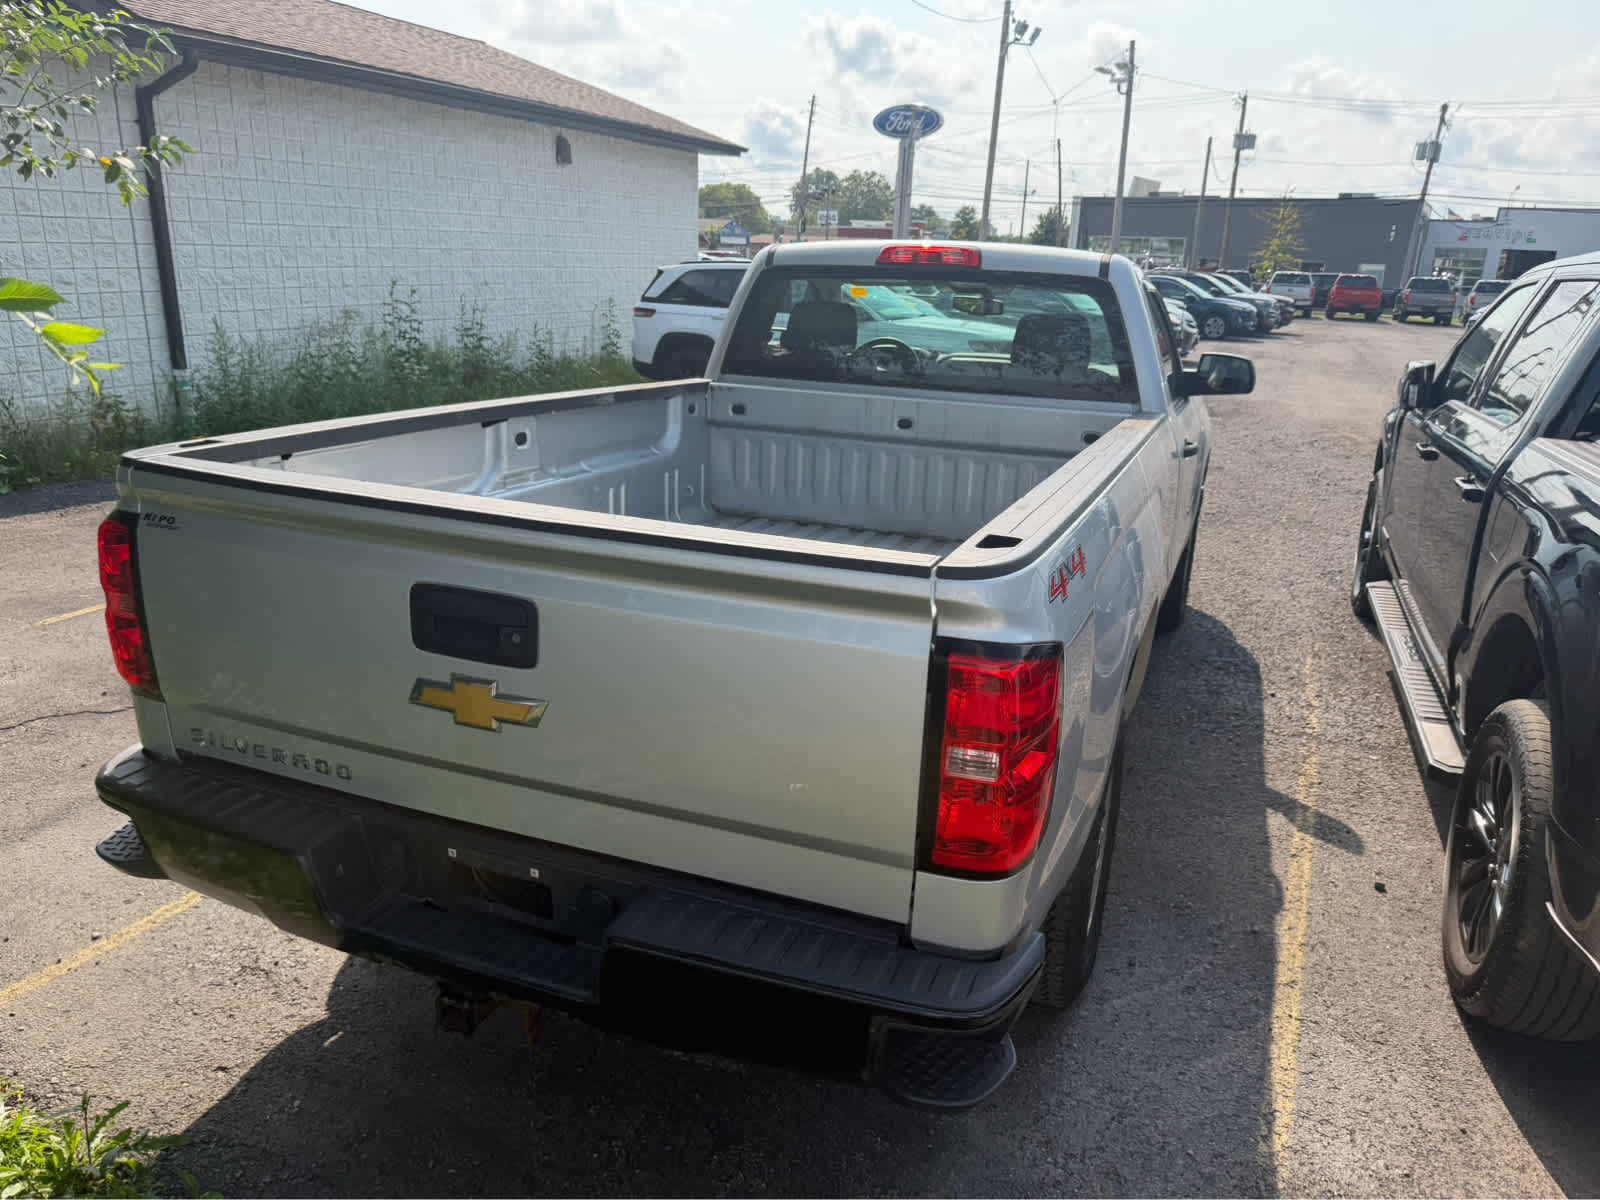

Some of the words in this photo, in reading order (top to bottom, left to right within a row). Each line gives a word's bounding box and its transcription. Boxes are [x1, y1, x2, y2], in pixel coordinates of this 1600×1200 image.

[886, 111, 926, 132] Ford
[143, 511, 176, 525] KIPO
[190, 727, 352, 780] SILVERADO
